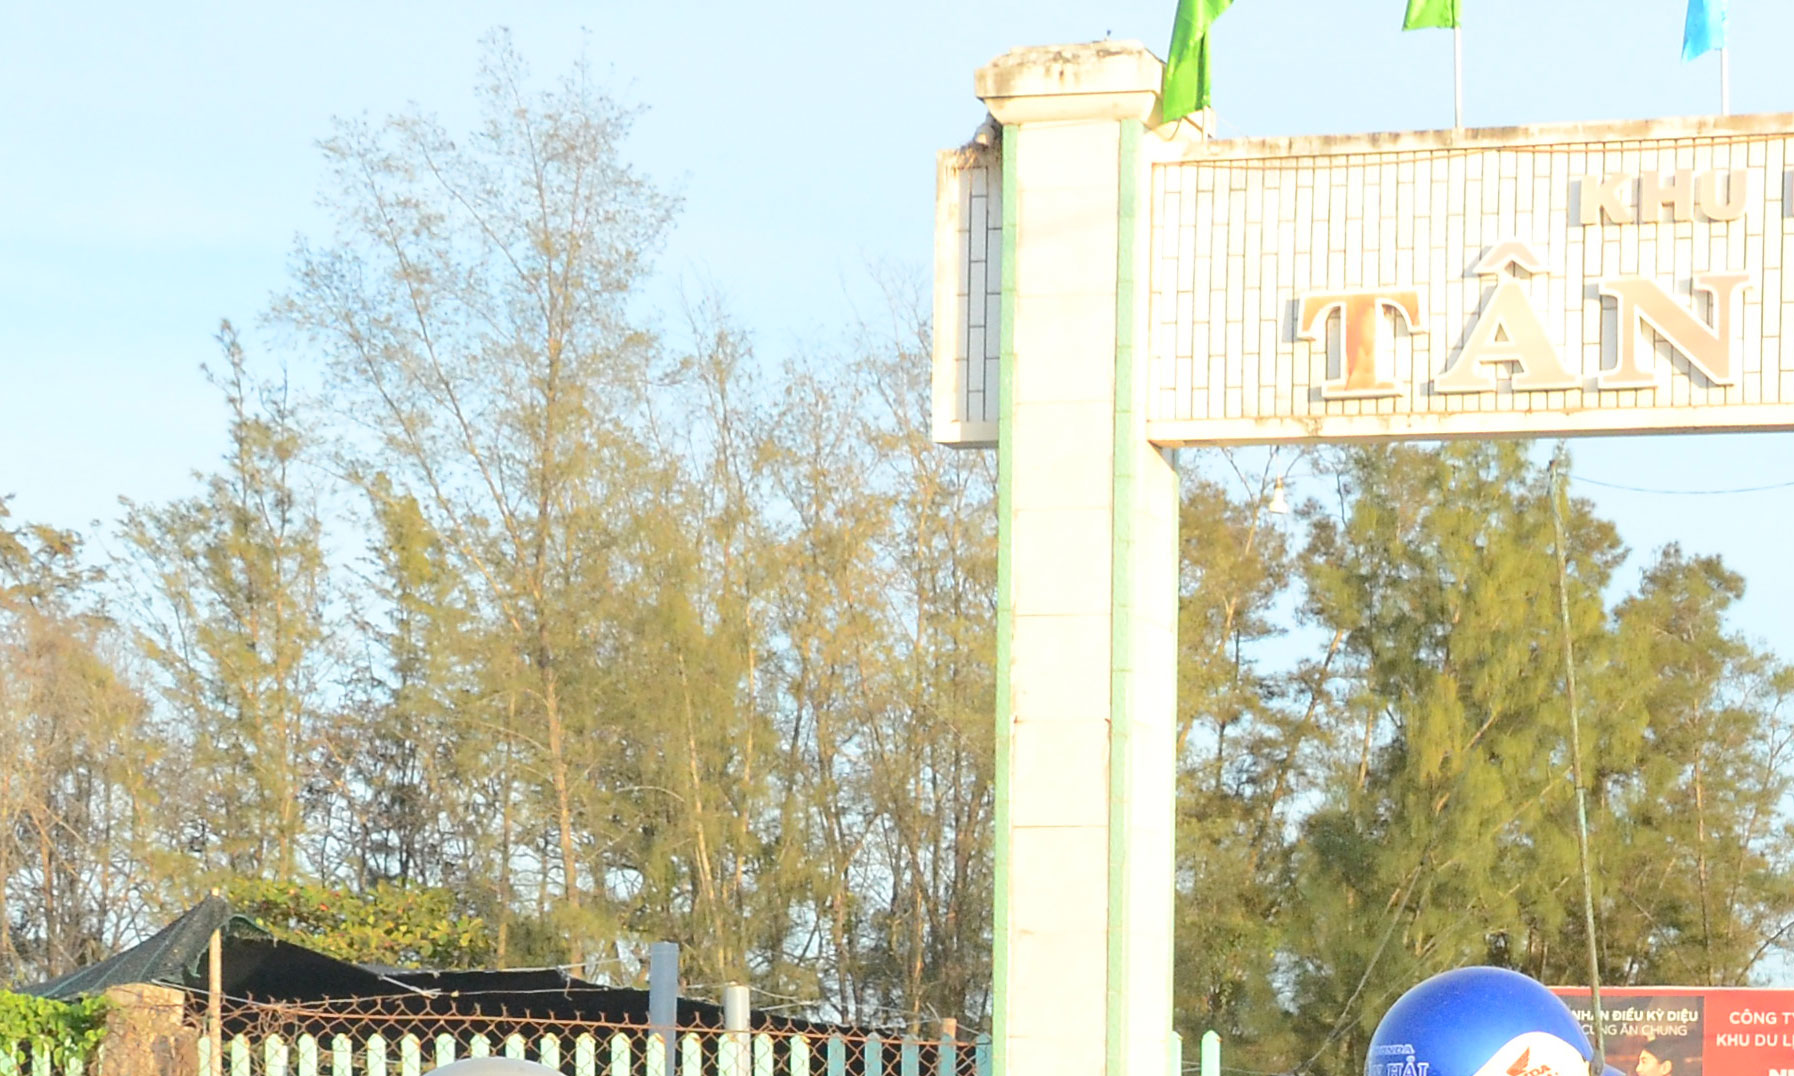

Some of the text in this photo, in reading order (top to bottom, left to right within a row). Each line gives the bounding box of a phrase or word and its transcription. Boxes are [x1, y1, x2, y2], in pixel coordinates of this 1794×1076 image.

[1580, 167, 1748, 227] KHU
[1297, 241, 1753, 400] TÂN
[1572, 1010, 1609, 1021] NHN
[1729, 1008, 1777, 1025] CÔNG
[1641, 1024, 1688, 1036] CHUNG
[1716, 1033, 1750, 1047] KHU
[1755, 1033, 1778, 1047] DU
